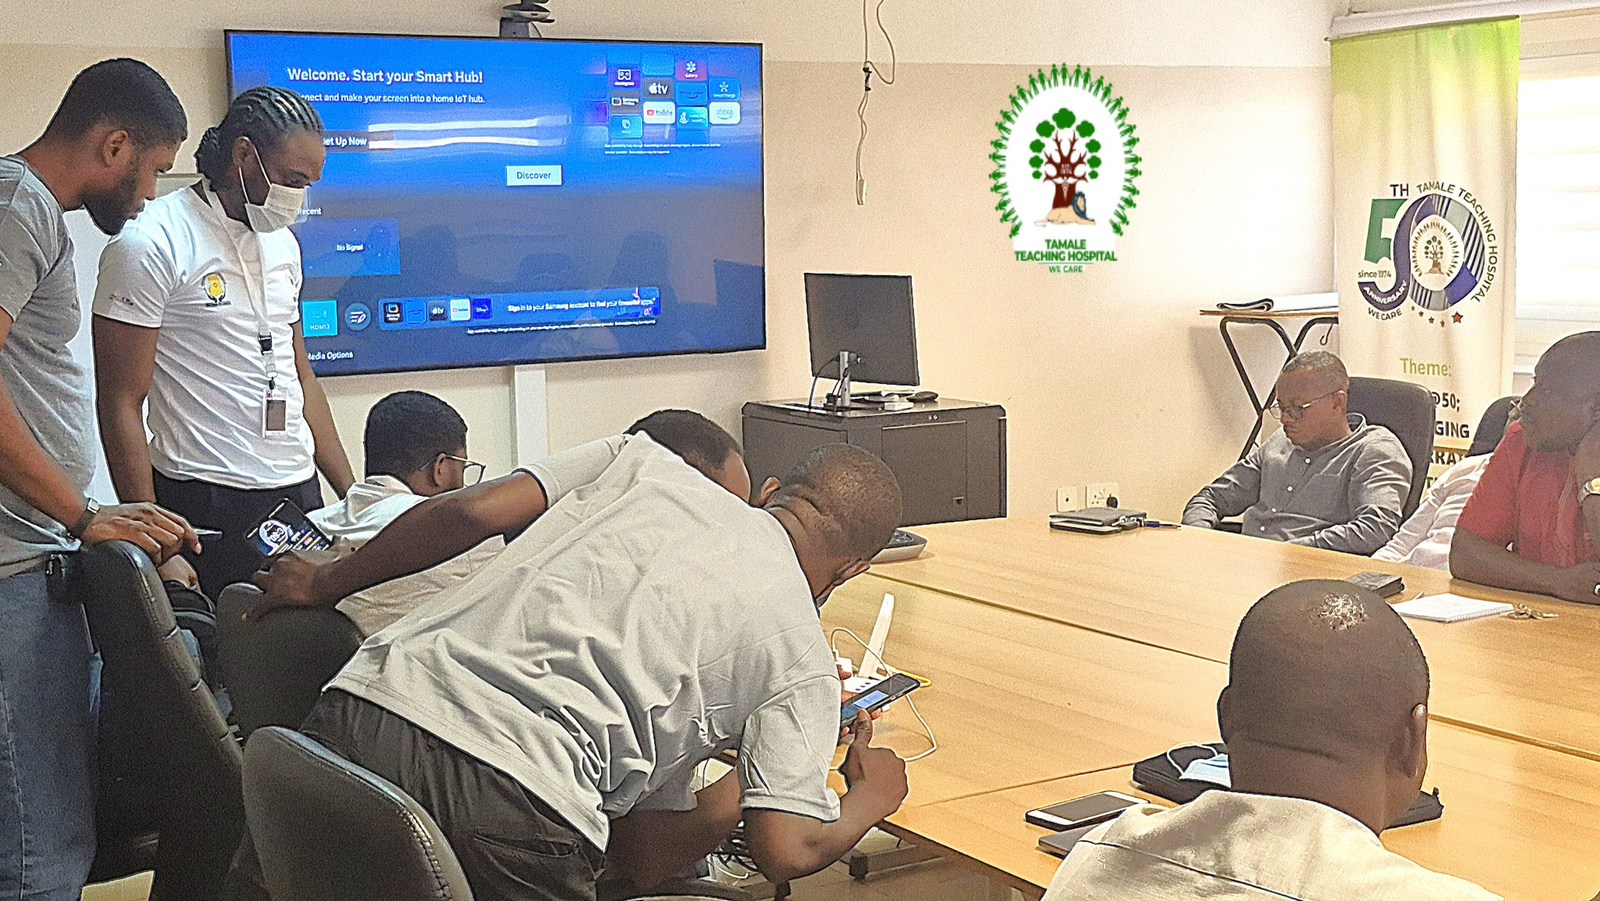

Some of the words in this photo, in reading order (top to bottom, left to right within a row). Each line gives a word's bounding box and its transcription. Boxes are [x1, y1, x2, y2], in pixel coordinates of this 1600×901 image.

[287, 67, 350, 82] Welcome.
[353, 68, 384, 82] Start
[385, 71, 414, 85] your
[415, 70, 453, 83] Smart
[454, 71, 484, 83] Hub!
[324, 92, 340, 102] and
[341, 94, 363, 102] make
[364, 95, 382, 104] your
[382, 95, 409, 103] screen
[409, 94, 425, 103] into
[432, 95, 454, 103] home
[468, 95, 485, 104] hub.
[335, 137, 348, 148] Up
[349, 136, 367, 146] Now
[516, 170, 552, 181] Discover
[1389, 183, 1409, 197] TH
[1416, 181, 1456, 194] TAMALE
[296, 207, 322, 215] Recent
[1457, 187, 1497, 243] TEACHING
[336, 244, 346, 252] No
[346, 244, 364, 253] Signal
[1357, 269, 1378, 279] since
[1470, 245, 1498, 303] HOSPITAL
[1367, 307, 1380, 319] WE
[1380, 308, 1403, 321] CARE
[326, 350, 354, 361] Options
[1399, 357, 1452, 377] Theme:
